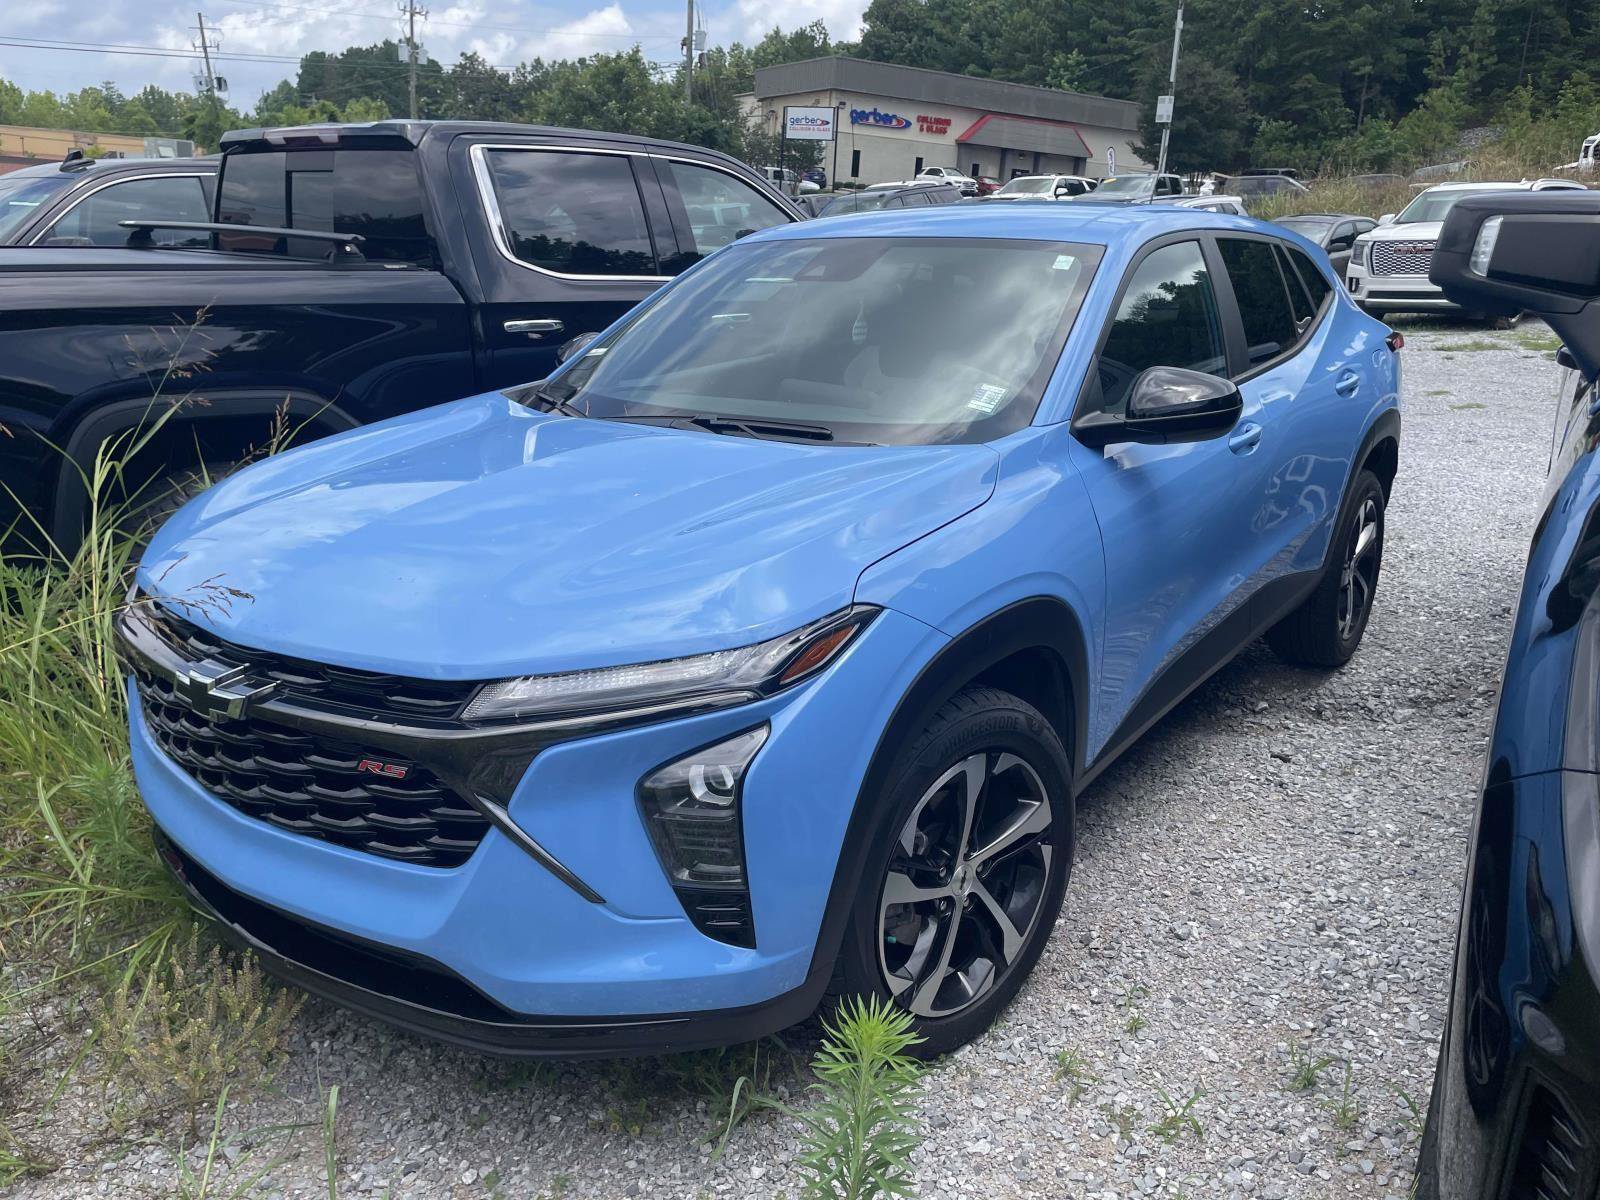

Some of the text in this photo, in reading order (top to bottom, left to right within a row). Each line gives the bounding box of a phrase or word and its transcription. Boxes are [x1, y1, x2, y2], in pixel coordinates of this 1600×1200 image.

[789, 116, 819, 126] gerber
[850, 108, 897, 125] gerber
[916, 115, 952, 126] COLLISION
[357, 759, 409, 778] RS
